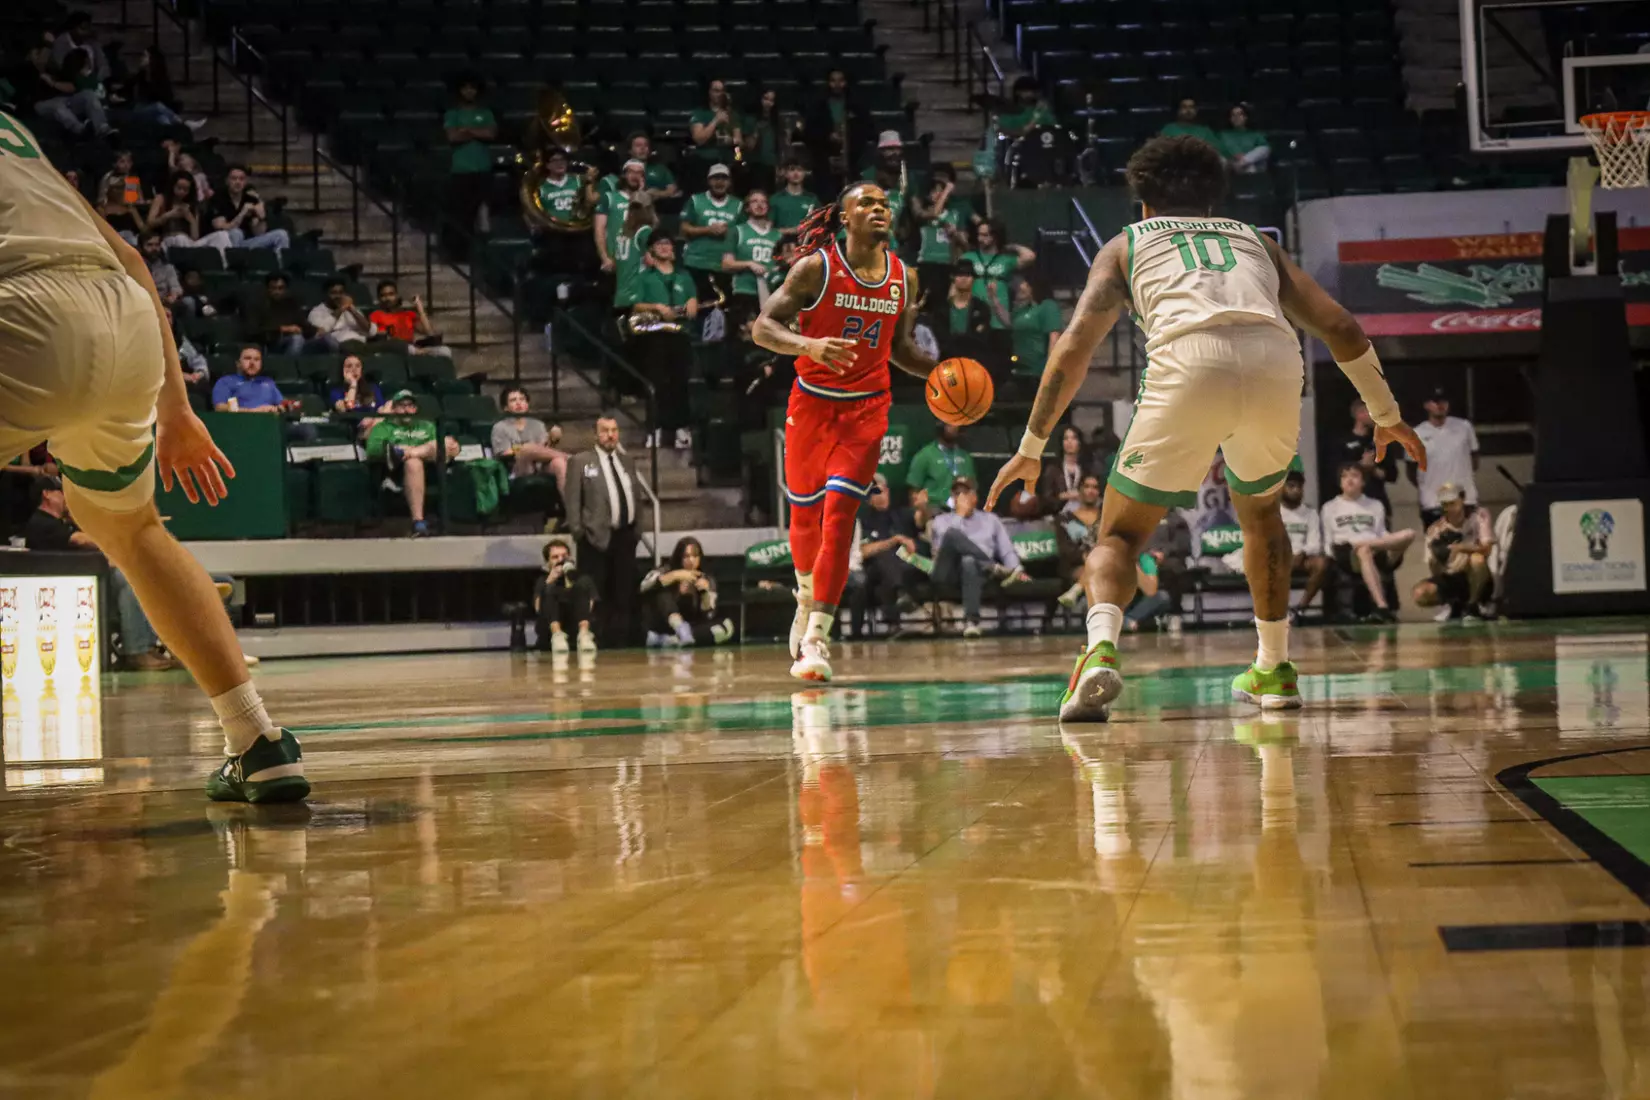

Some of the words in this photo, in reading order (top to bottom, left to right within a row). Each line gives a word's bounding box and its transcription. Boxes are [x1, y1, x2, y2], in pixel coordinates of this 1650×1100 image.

[1170, 231, 1238, 272] 10
[834, 292, 899, 315] BULLDOGS
[841, 315, 883, 349] 24
